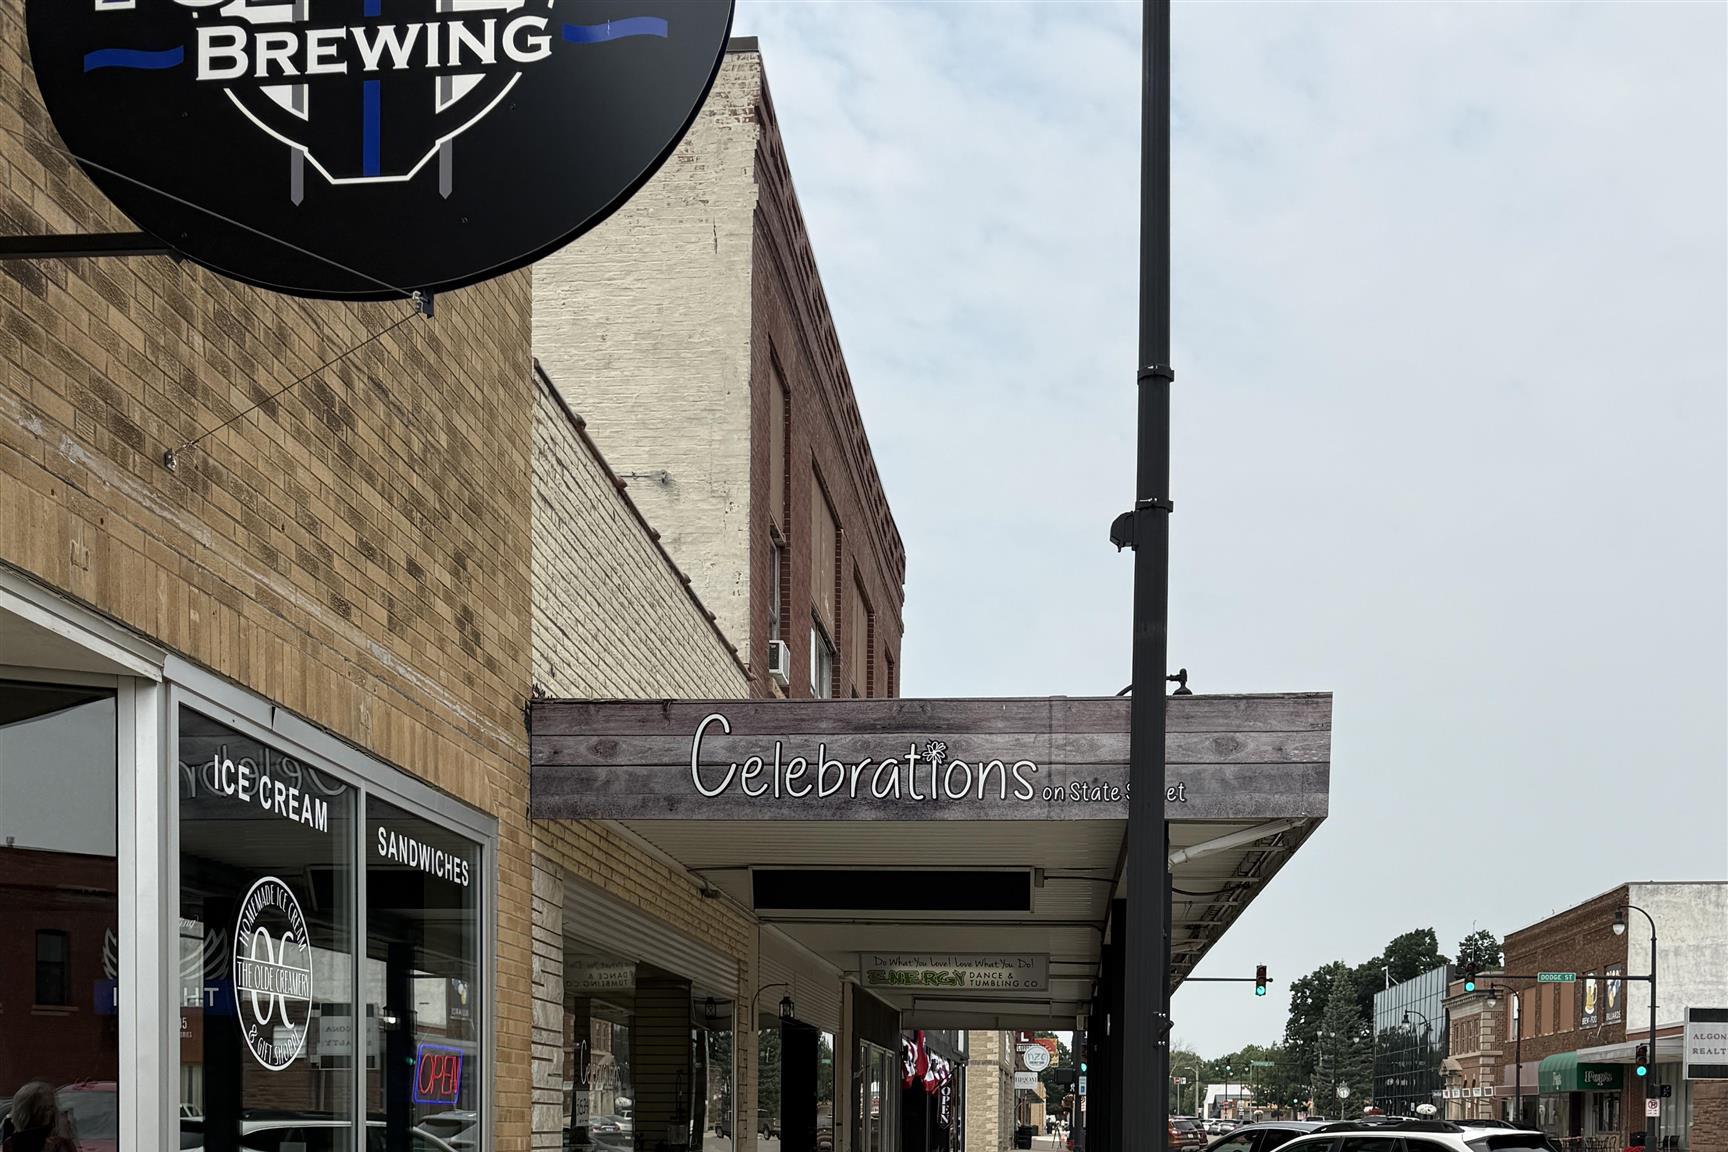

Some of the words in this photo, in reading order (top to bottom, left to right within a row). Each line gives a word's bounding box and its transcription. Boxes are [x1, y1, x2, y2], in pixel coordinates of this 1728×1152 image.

[196, 16, 553, 81] BREWING
[690, 713, 1039, 800] Celebrations
[1042, 786, 1065, 801] on
[1069, 782, 1121, 801] State
[214, 754, 251, 802] ICE
[260, 775, 328, 833] CREAM
[378, 826, 469, 886] SANDWICHES
[239, 884, 275, 947] HOMEMADE
[276, 886, 288, 912] ICE
[288, 902, 307, 952] CREAM
[237, 961, 252, 988] THE
[254, 964, 274, 992] OLDE
[275, 968, 309, 997] CREAMERY
[866, 969, 967, 986] ENERGY
[874, 956, 887, 967] Do
[914, 956, 927, 968] You
[969, 980, 1020, 988] TUMBLING
[257, 1037, 273, 1064] GIFT
[1692, 1047, 1728, 1055] REALT
[419, 1052, 461, 1095] OPEN
[941, 1086, 951, 1124] OPEN
